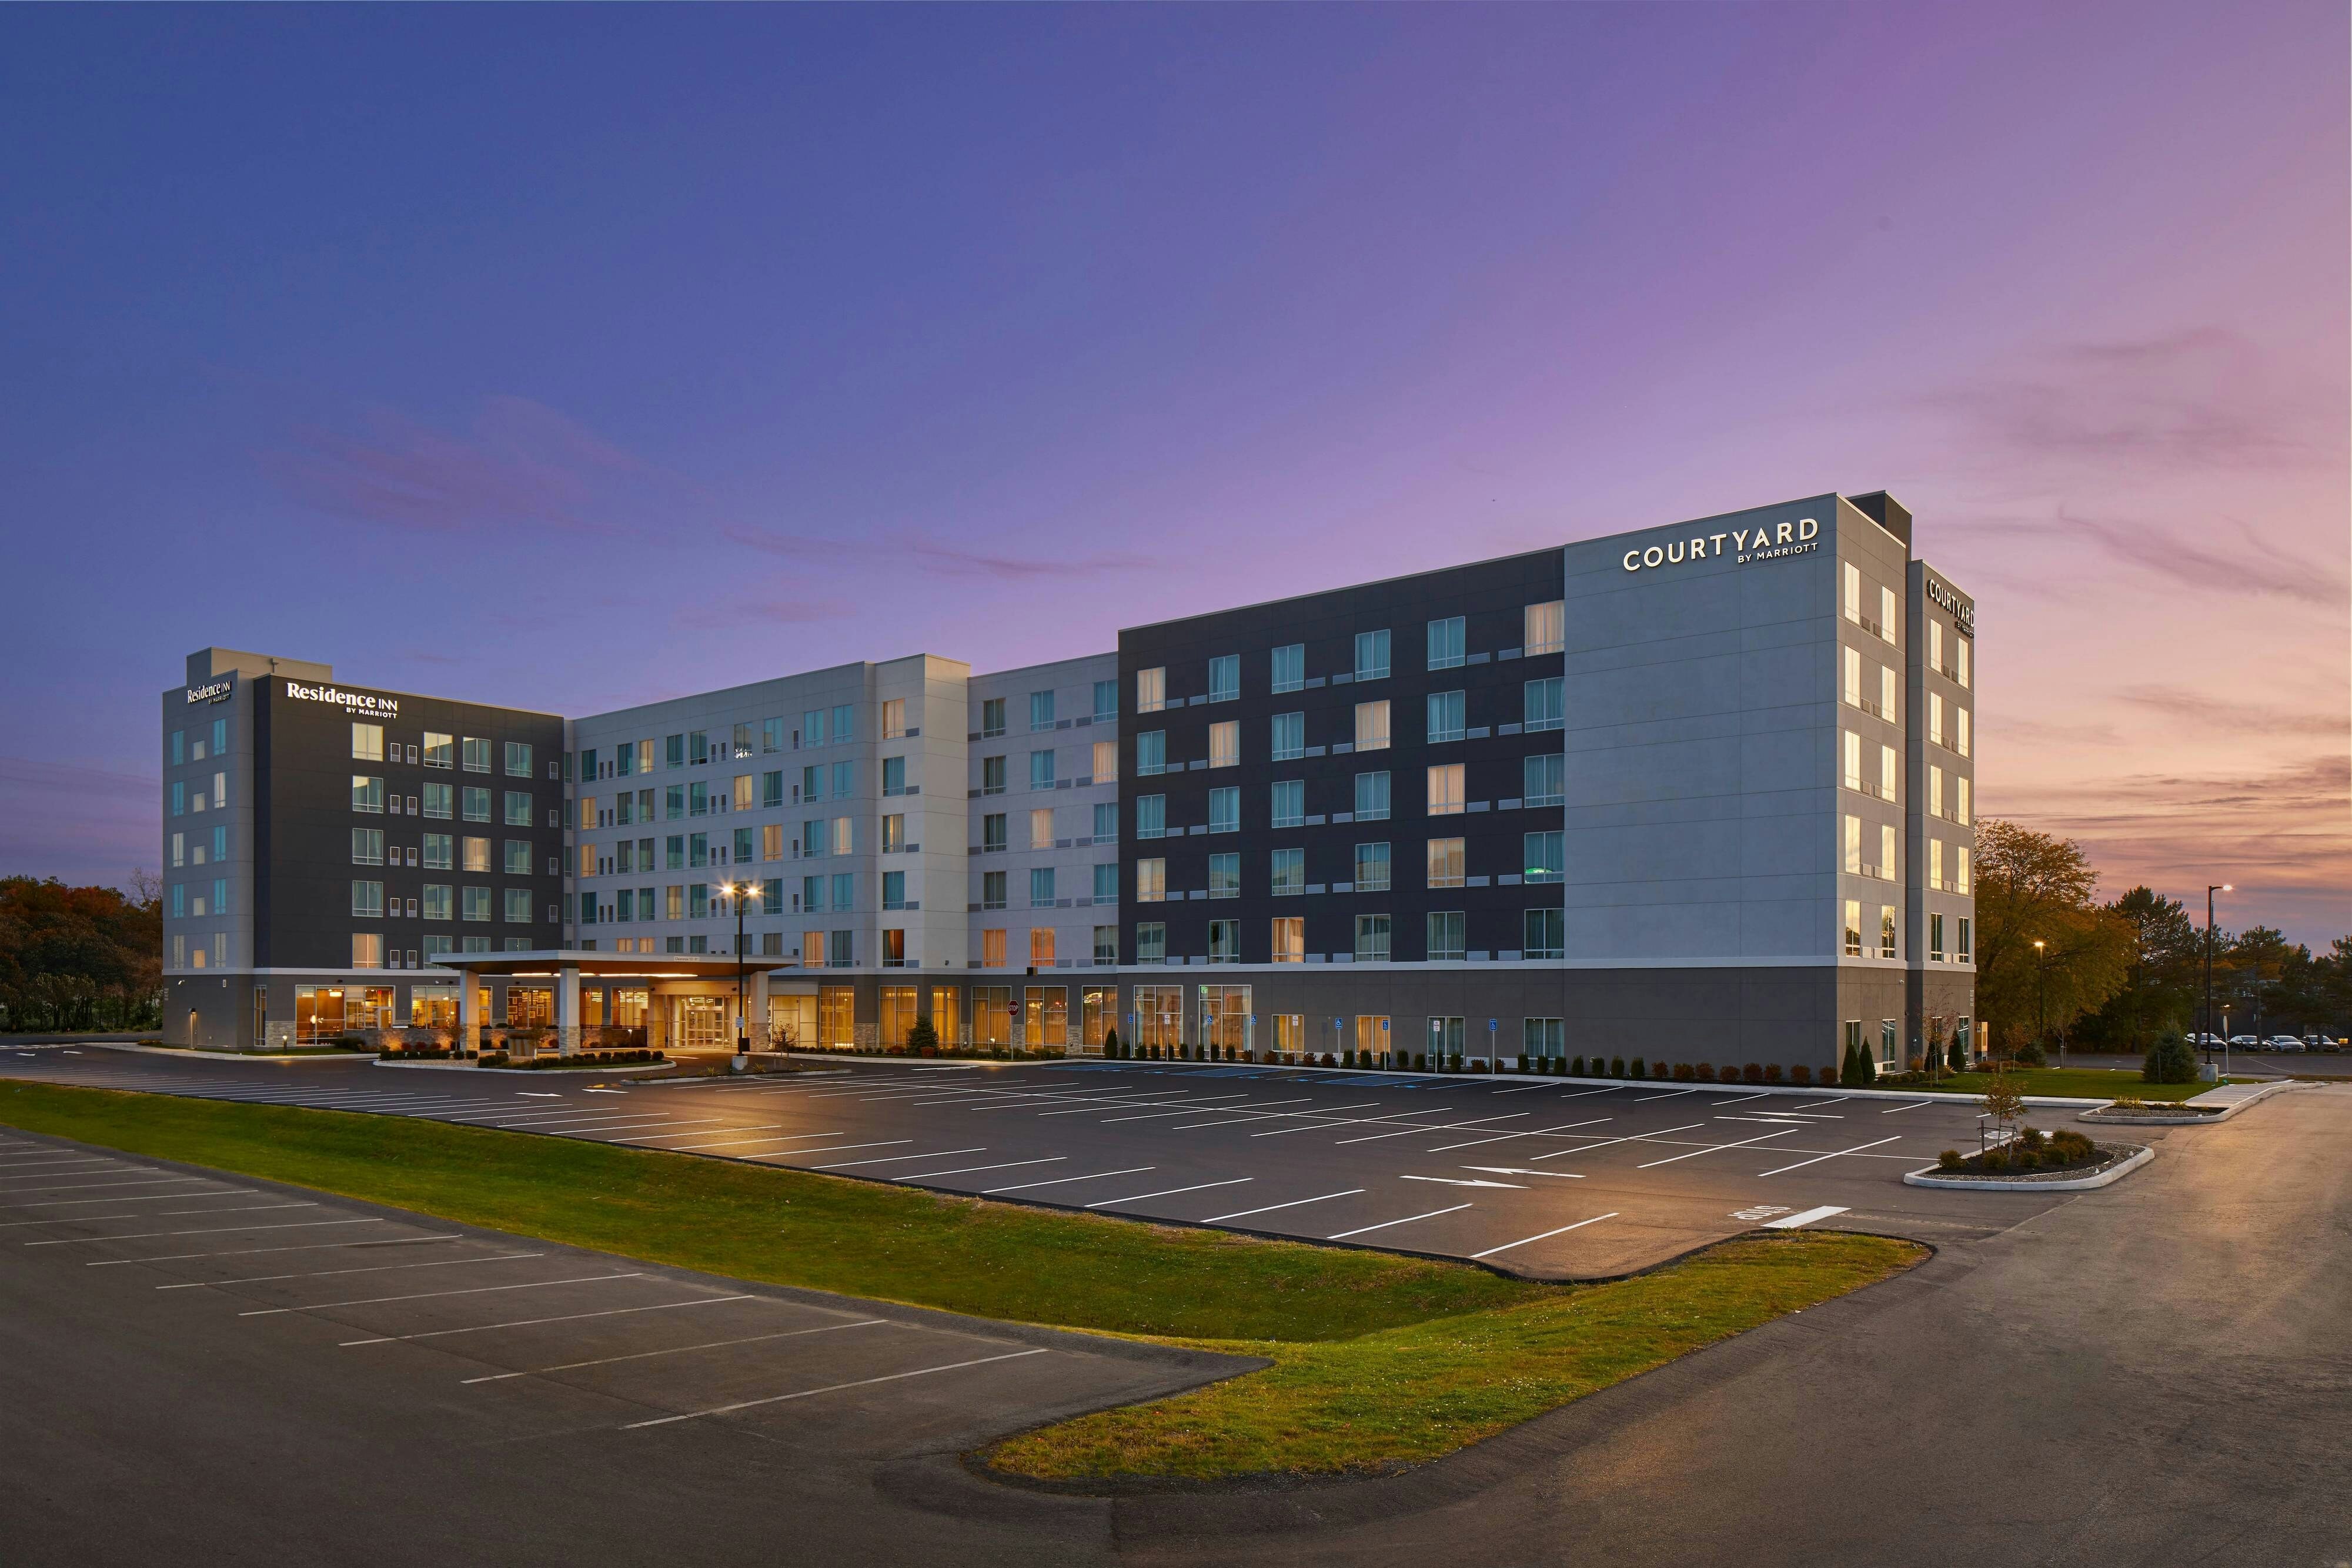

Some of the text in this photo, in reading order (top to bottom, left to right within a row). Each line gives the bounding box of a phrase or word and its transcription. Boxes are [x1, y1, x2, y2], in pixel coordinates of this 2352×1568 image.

[1623, 518, 1819, 571] COURTYARD
[1738, 542, 1819, 564] BY MARRIOTT
[1929, 579, 1975, 627] COURTYARD
[188, 681, 230, 703] Residence INN
[287, 682, 398, 712] Residence INN
[359, 708, 397, 719] MARRIOTT
